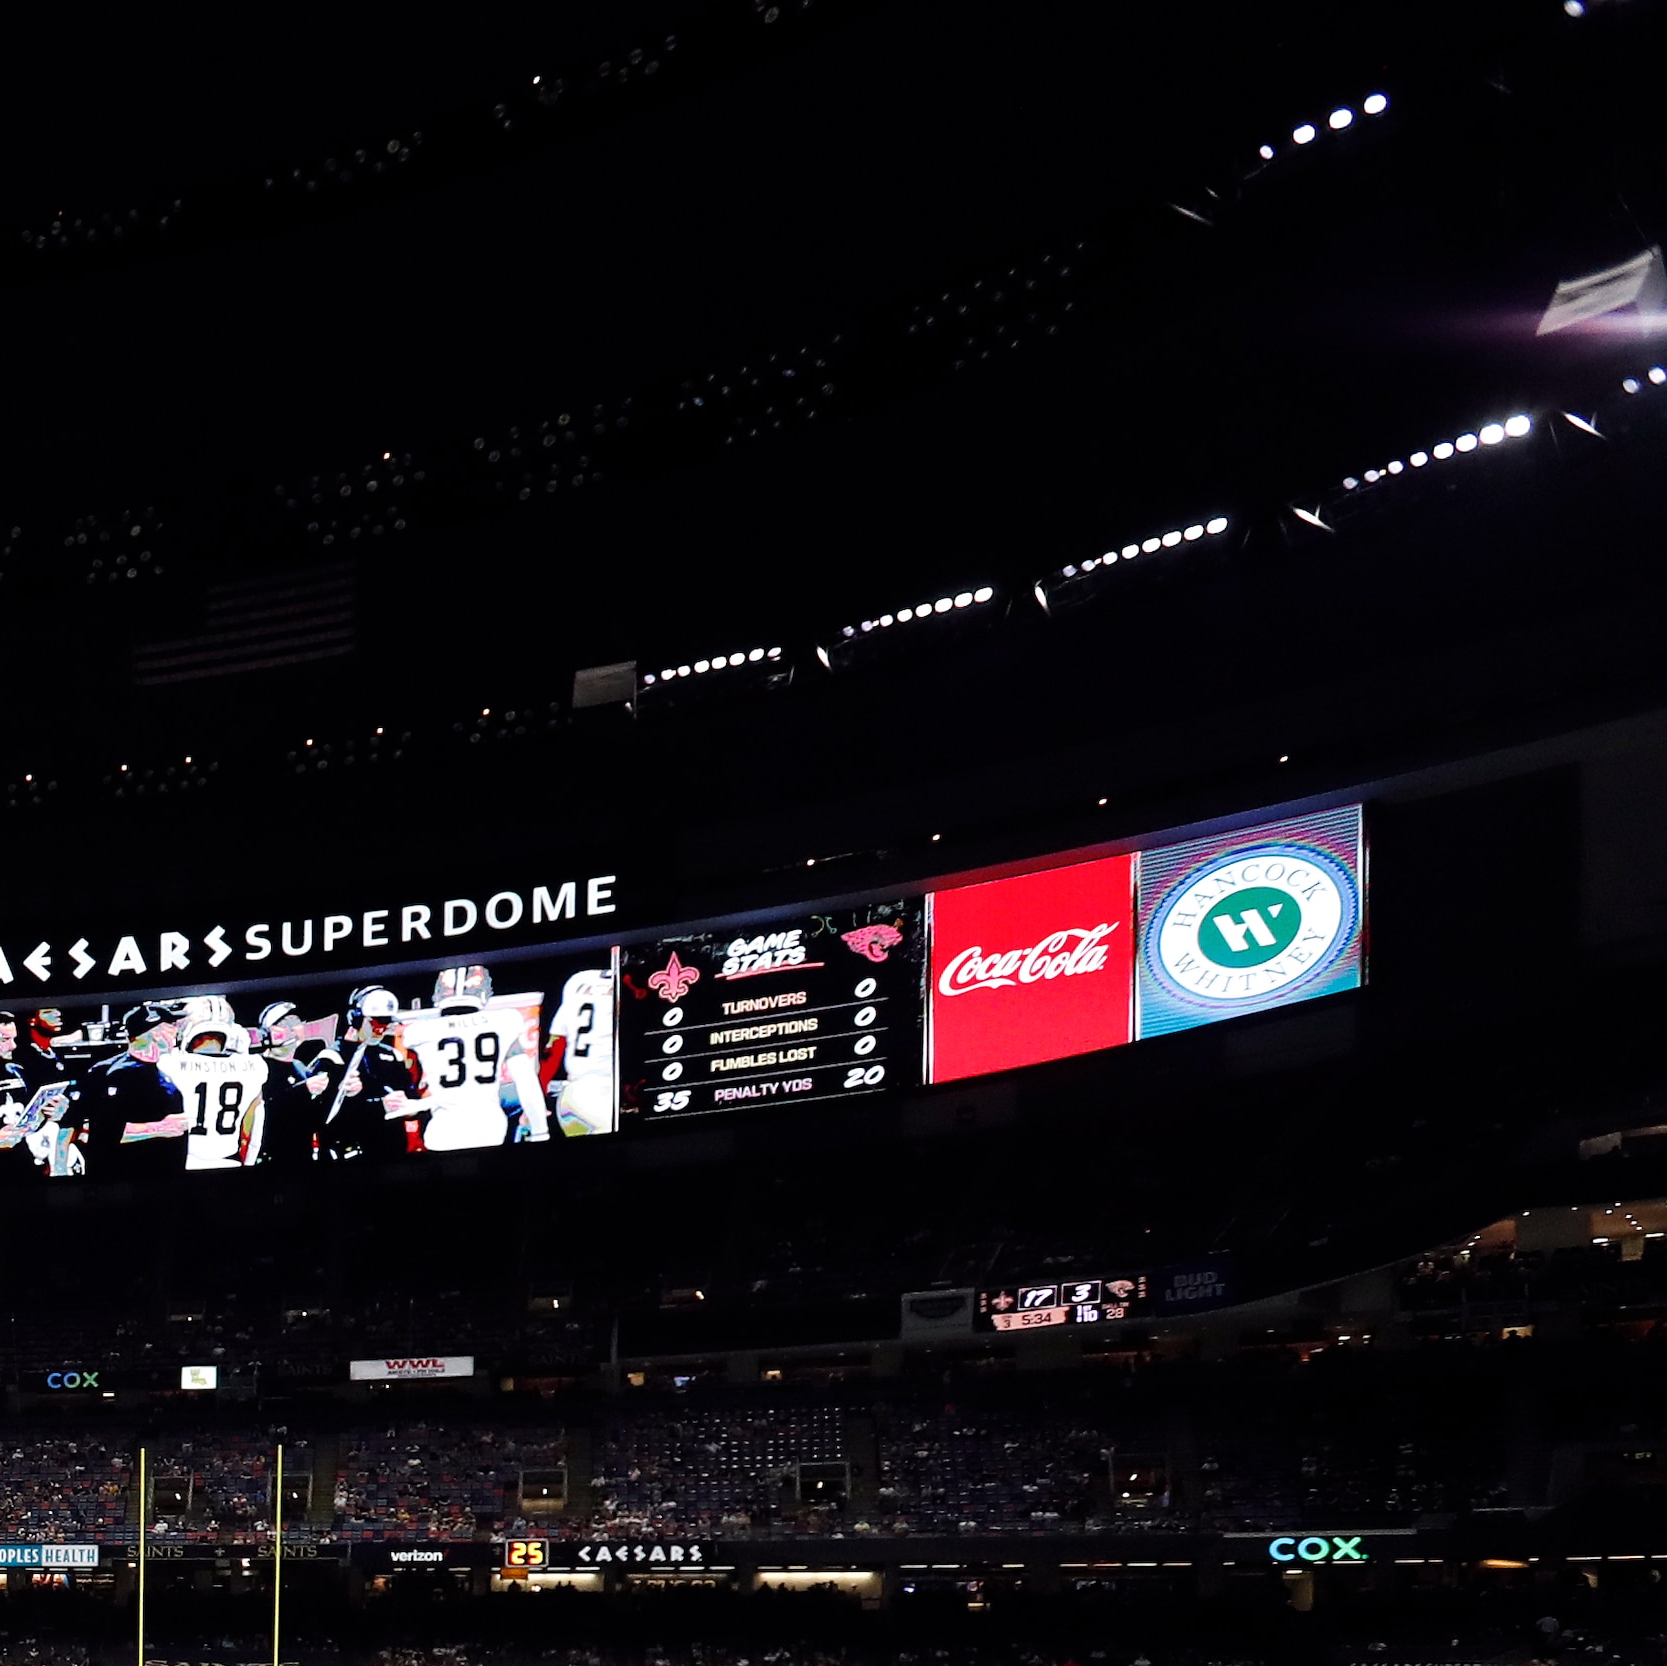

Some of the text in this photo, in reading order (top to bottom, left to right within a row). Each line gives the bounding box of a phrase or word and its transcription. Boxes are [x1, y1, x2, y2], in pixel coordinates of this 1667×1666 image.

[244, 874, 617, 962] SUPERDOME
[1172, 863, 1328, 993] HANCOCK WHITNEY
[726, 929, 803, 958] GAME
[721, 945, 807, 977] STATS
[662, 977, 877, 1027] 0 TURNOVERS 0
[662, 1006, 877, 1055] 0 INTERCEPTIONS 0
[180, 1061, 237, 1073] WINSTON
[437, 1031, 500, 1089] 39
[662, 1034, 877, 1082] 0 FUMBLES LOST 0
[653, 1064, 886, 1113] 35 PENALTY YDS 20
[189, 1081, 244, 1136] 18
[1022, 1289, 1054, 1307] 17
[1071, 1284, 1092, 1303] 3
[1021, 1312, 1052, 1326] 5:34
[385, 1358, 446, 1370] WWL
[46, 1370, 100, 1389] COX
[44, 1547, 98, 1564] HEALTH
[390, 1550, 444, 1563] verizon
[510, 1541, 544, 1565] 25
[577, 1545, 703, 1562] CAESARS
